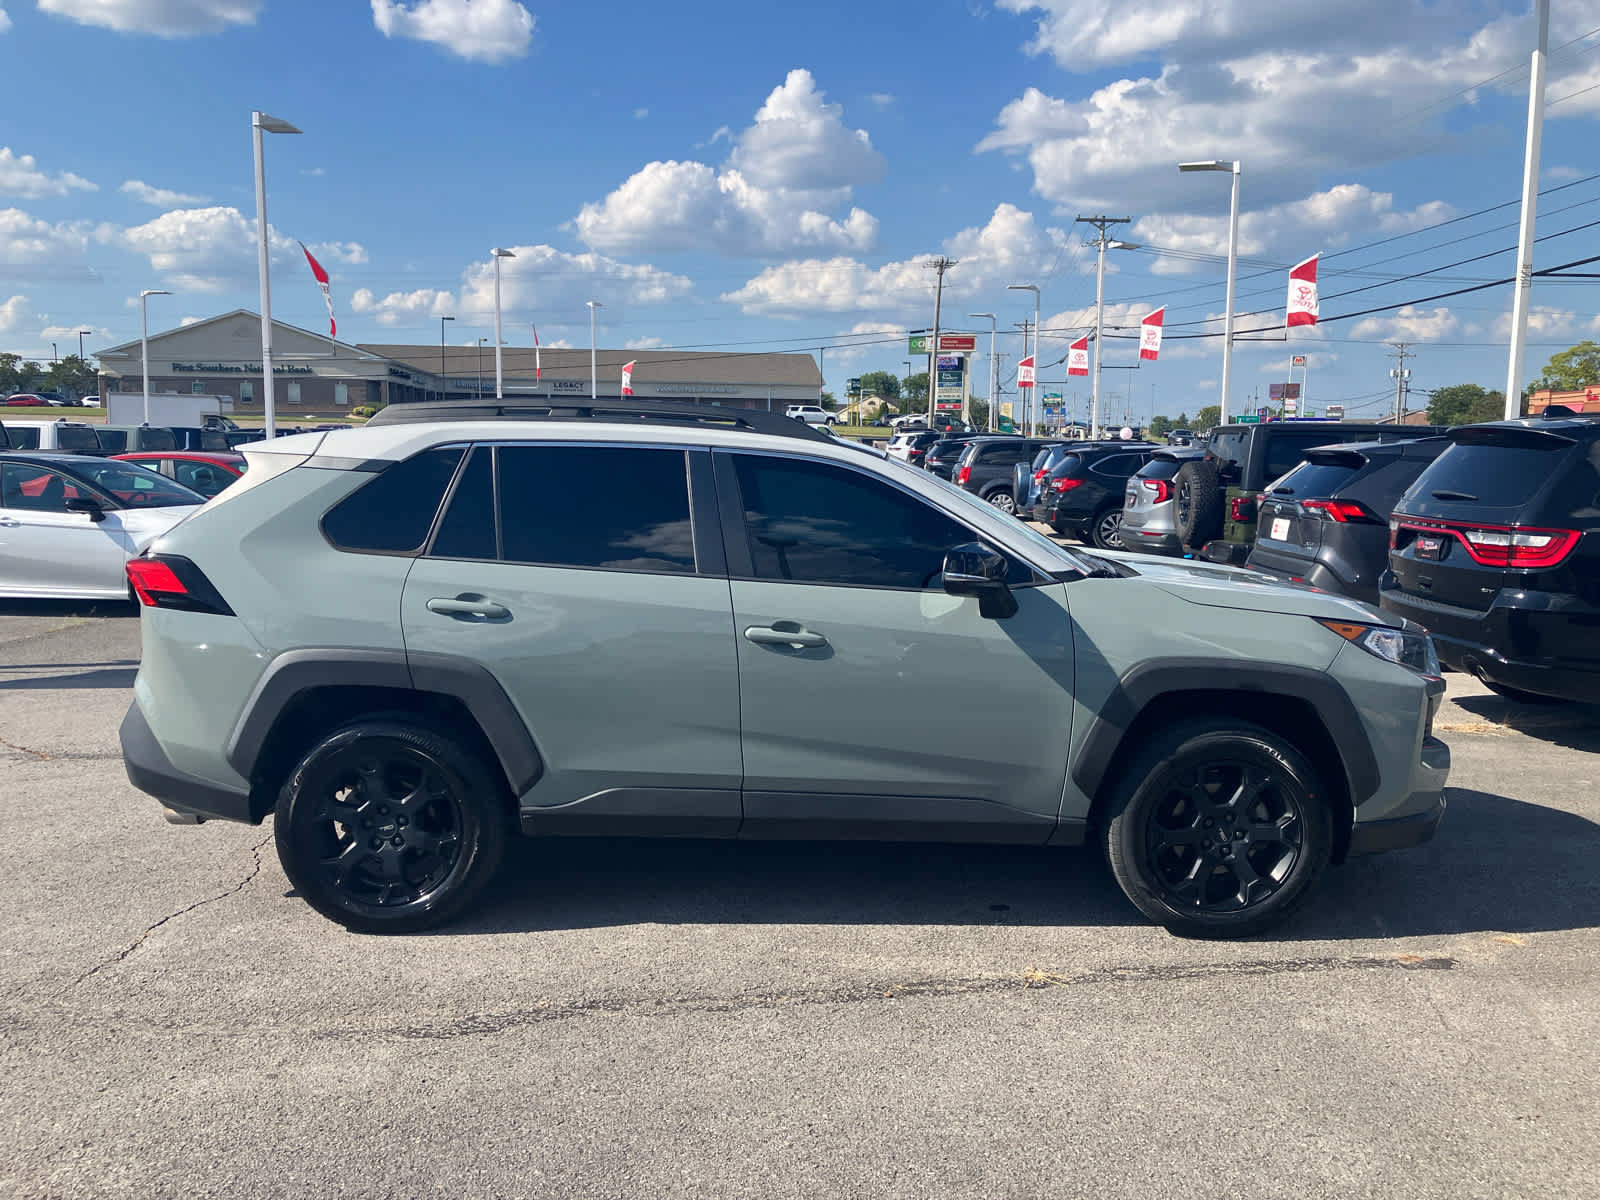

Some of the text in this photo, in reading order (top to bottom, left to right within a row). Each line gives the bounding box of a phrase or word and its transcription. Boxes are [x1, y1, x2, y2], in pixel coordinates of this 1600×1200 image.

[172, 362, 313, 374] First Southern Natinal Bank
